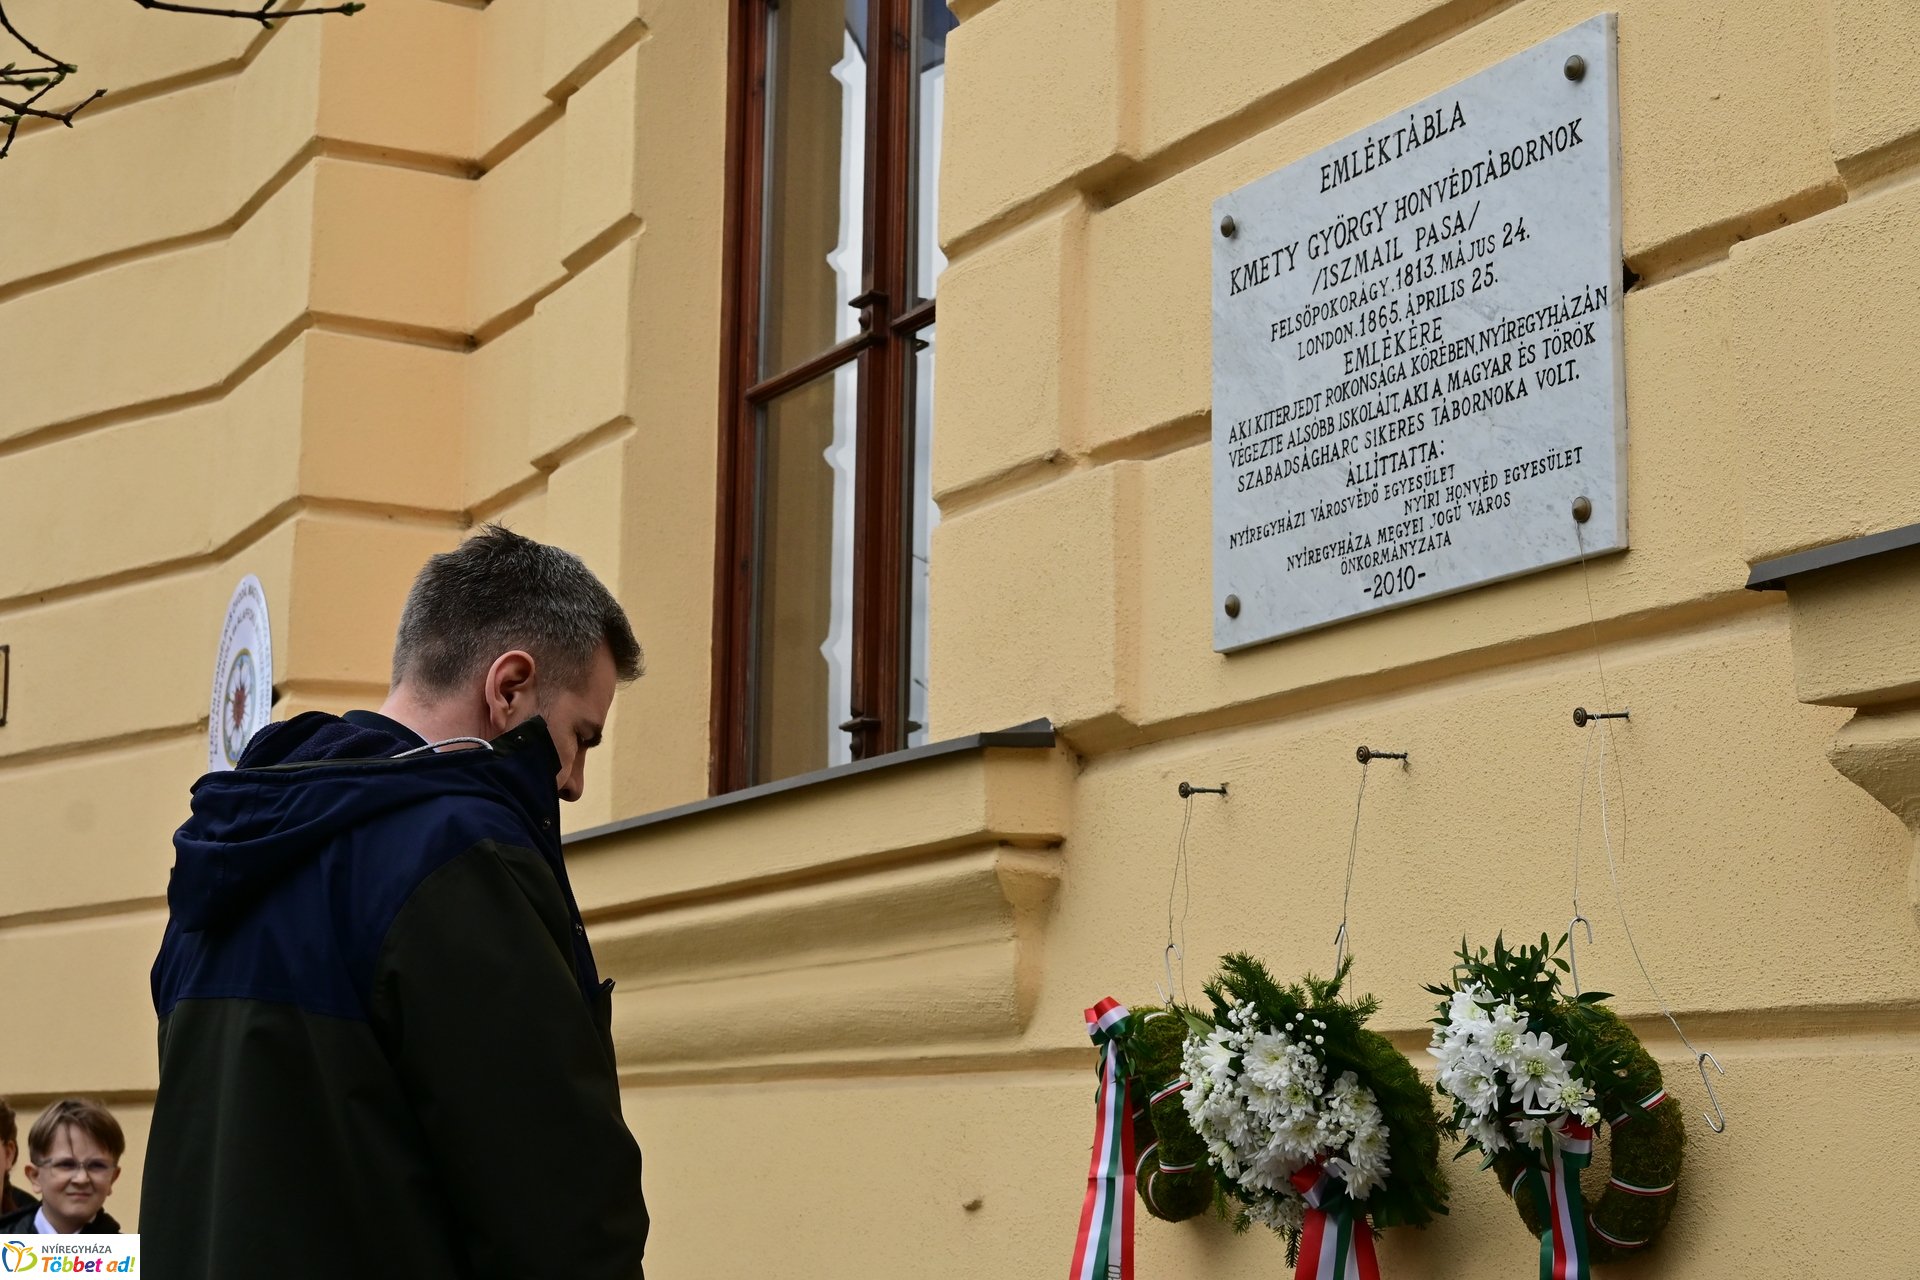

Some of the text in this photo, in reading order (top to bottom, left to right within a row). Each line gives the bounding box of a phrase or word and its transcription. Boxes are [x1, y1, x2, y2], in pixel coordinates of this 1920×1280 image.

[1320, 101, 1466, 193] EMLÉKTÁBLA
[1230, 118, 1583, 296] KMETY GYÖRGY HONVÉDTÁBORNOK
[1312, 200, 1480, 295] /ISZMAIL PASA/
[1441, 233, 1495, 273] MÁJUS
[1503, 217, 1530, 248] 24.
[1472, 262, 1498, 293] 25.
[1228, 418, 1251, 444] AKI
[1254, 393, 1322, 434] KITERJEDT
[1325, 362, 1407, 407] ROKONSÁGA
[1479, 285, 1608, 352] NYÍREGYHÁZÁN
[1344, 317, 1443, 375] EMLÉKÉRE
[1229, 434, 1283, 468] VÉGEZTE
[1287, 416, 1334, 449] ALSÓBB
[1447, 353, 1512, 393] MAGYAR
[1518, 341, 1535, 368] ÉS
[1543, 321, 1595, 359] TÖRÖK
[1237, 359, 1580, 493] SZABADSÁGHARC SIKERES TÁBORNOKA VOLT.
[1346, 439, 1444, 487] ÁLLÍTTATTA:
[1404, 446, 1582, 516] NYÍRI HONVÉD EGYESÜLET
[1230, 464, 1455, 549] NYÍREGYHÁZI VÁROSVÉDŐ EGYESÜLET
[1287, 491, 1511, 571] NYÍREGYHÁZA MEGYEI JOGÚ VÁROS
[1341, 530, 1452, 575] ÖNKORMÁNYZATA
